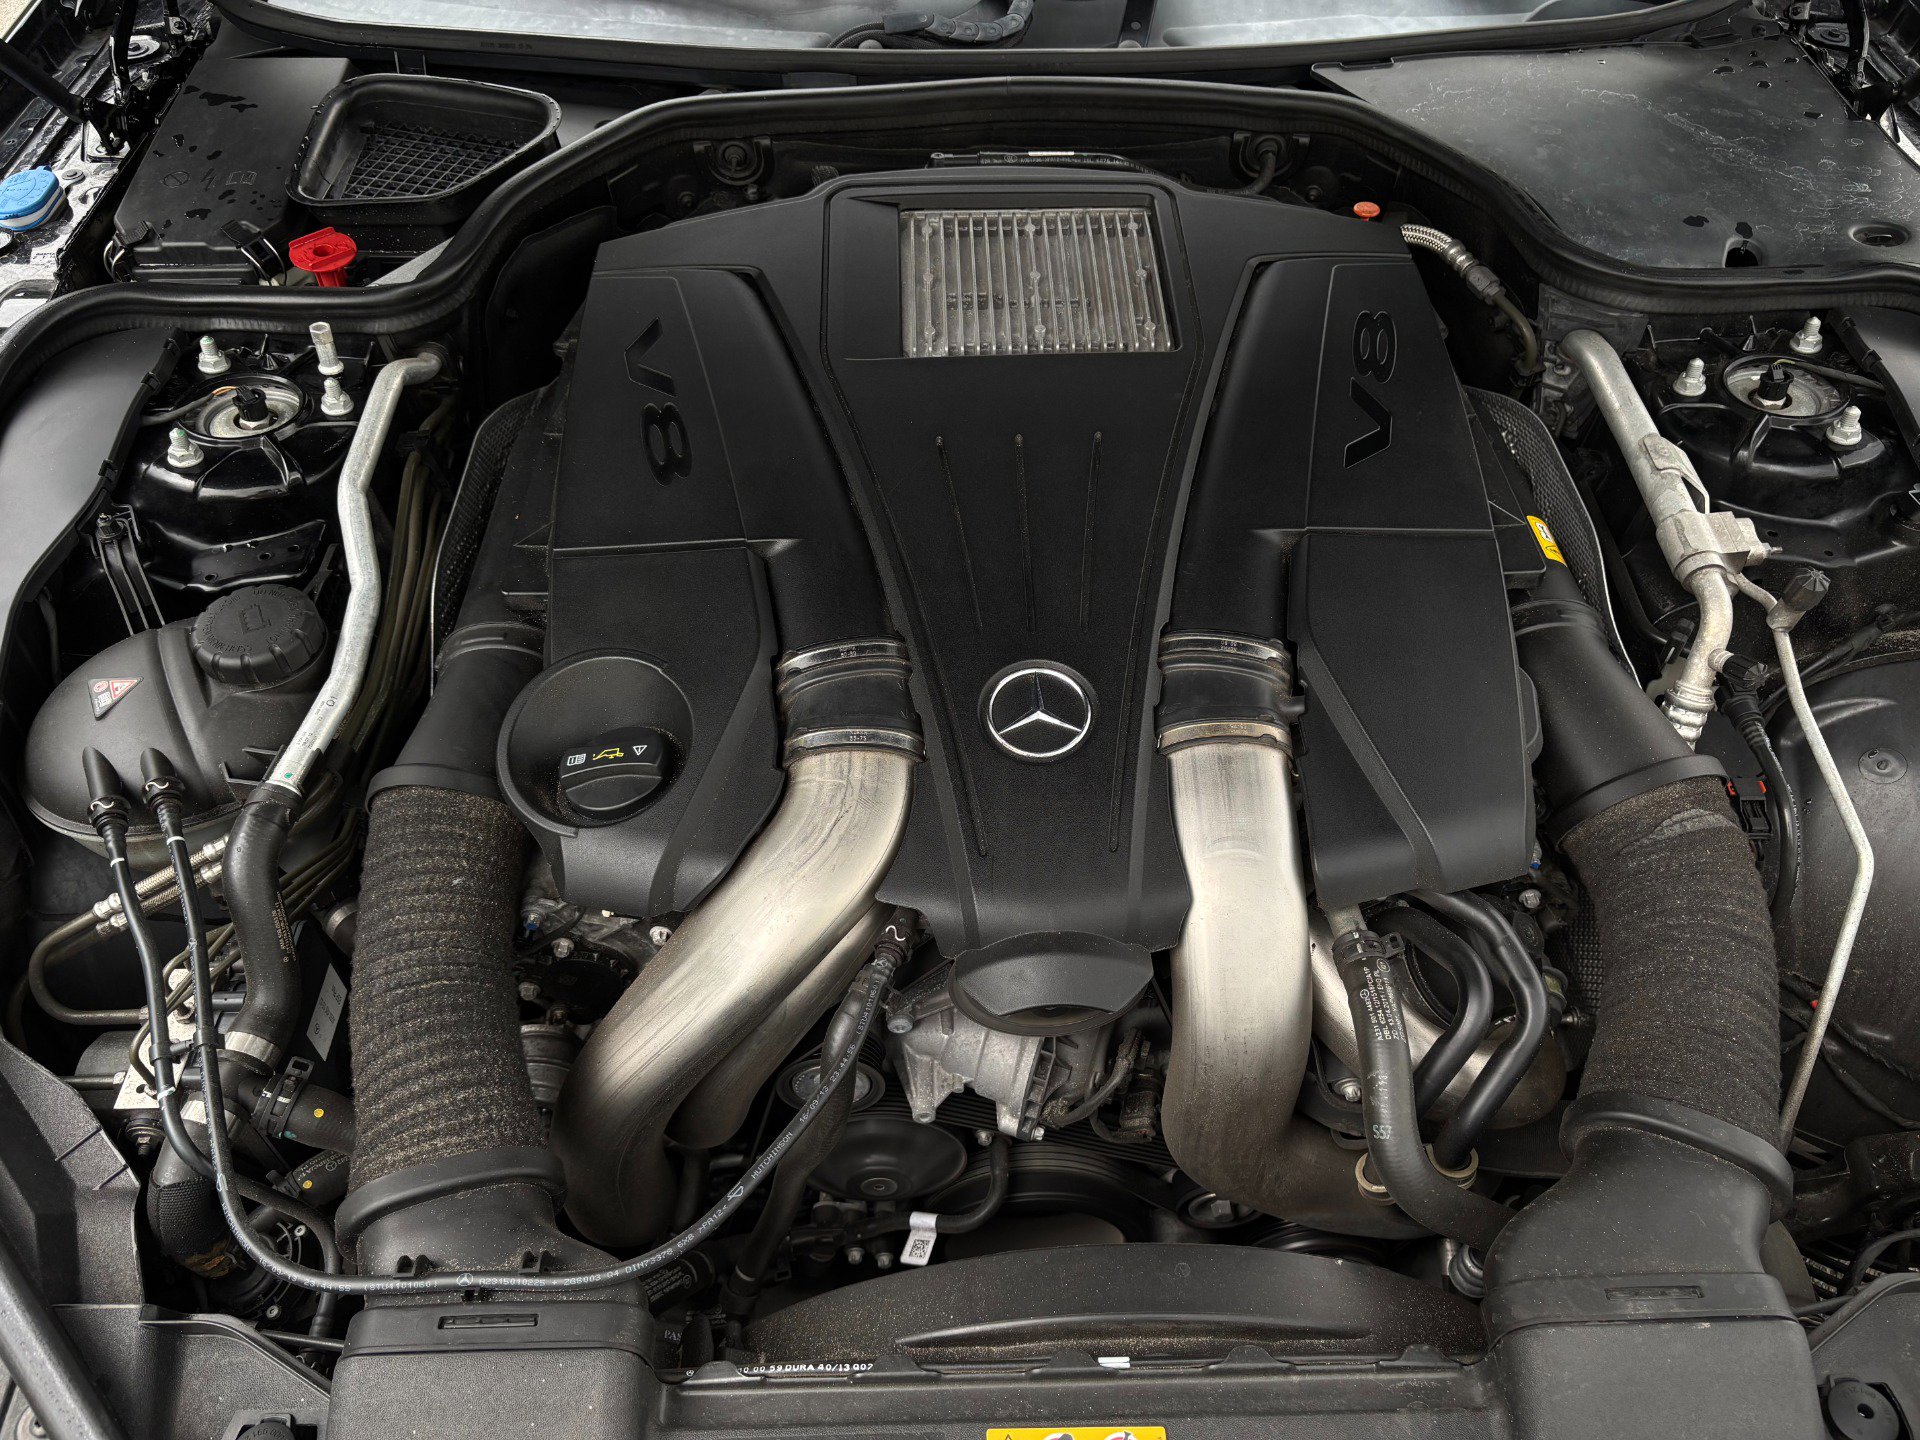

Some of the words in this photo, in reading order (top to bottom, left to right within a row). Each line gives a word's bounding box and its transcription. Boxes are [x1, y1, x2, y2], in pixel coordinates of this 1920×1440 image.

[624, 316, 693, 486] V8
[1343, 310, 1397, 469] V8
[1382, 1025, 1392, 1040] DBL
[1372, 1124, 1392, 1140] S57
[751, 1131, 794, 1181] HUTCHINSON
[785, 1363, 815, 1372] DURA
[817, 1363, 850, 1372] 40/13
